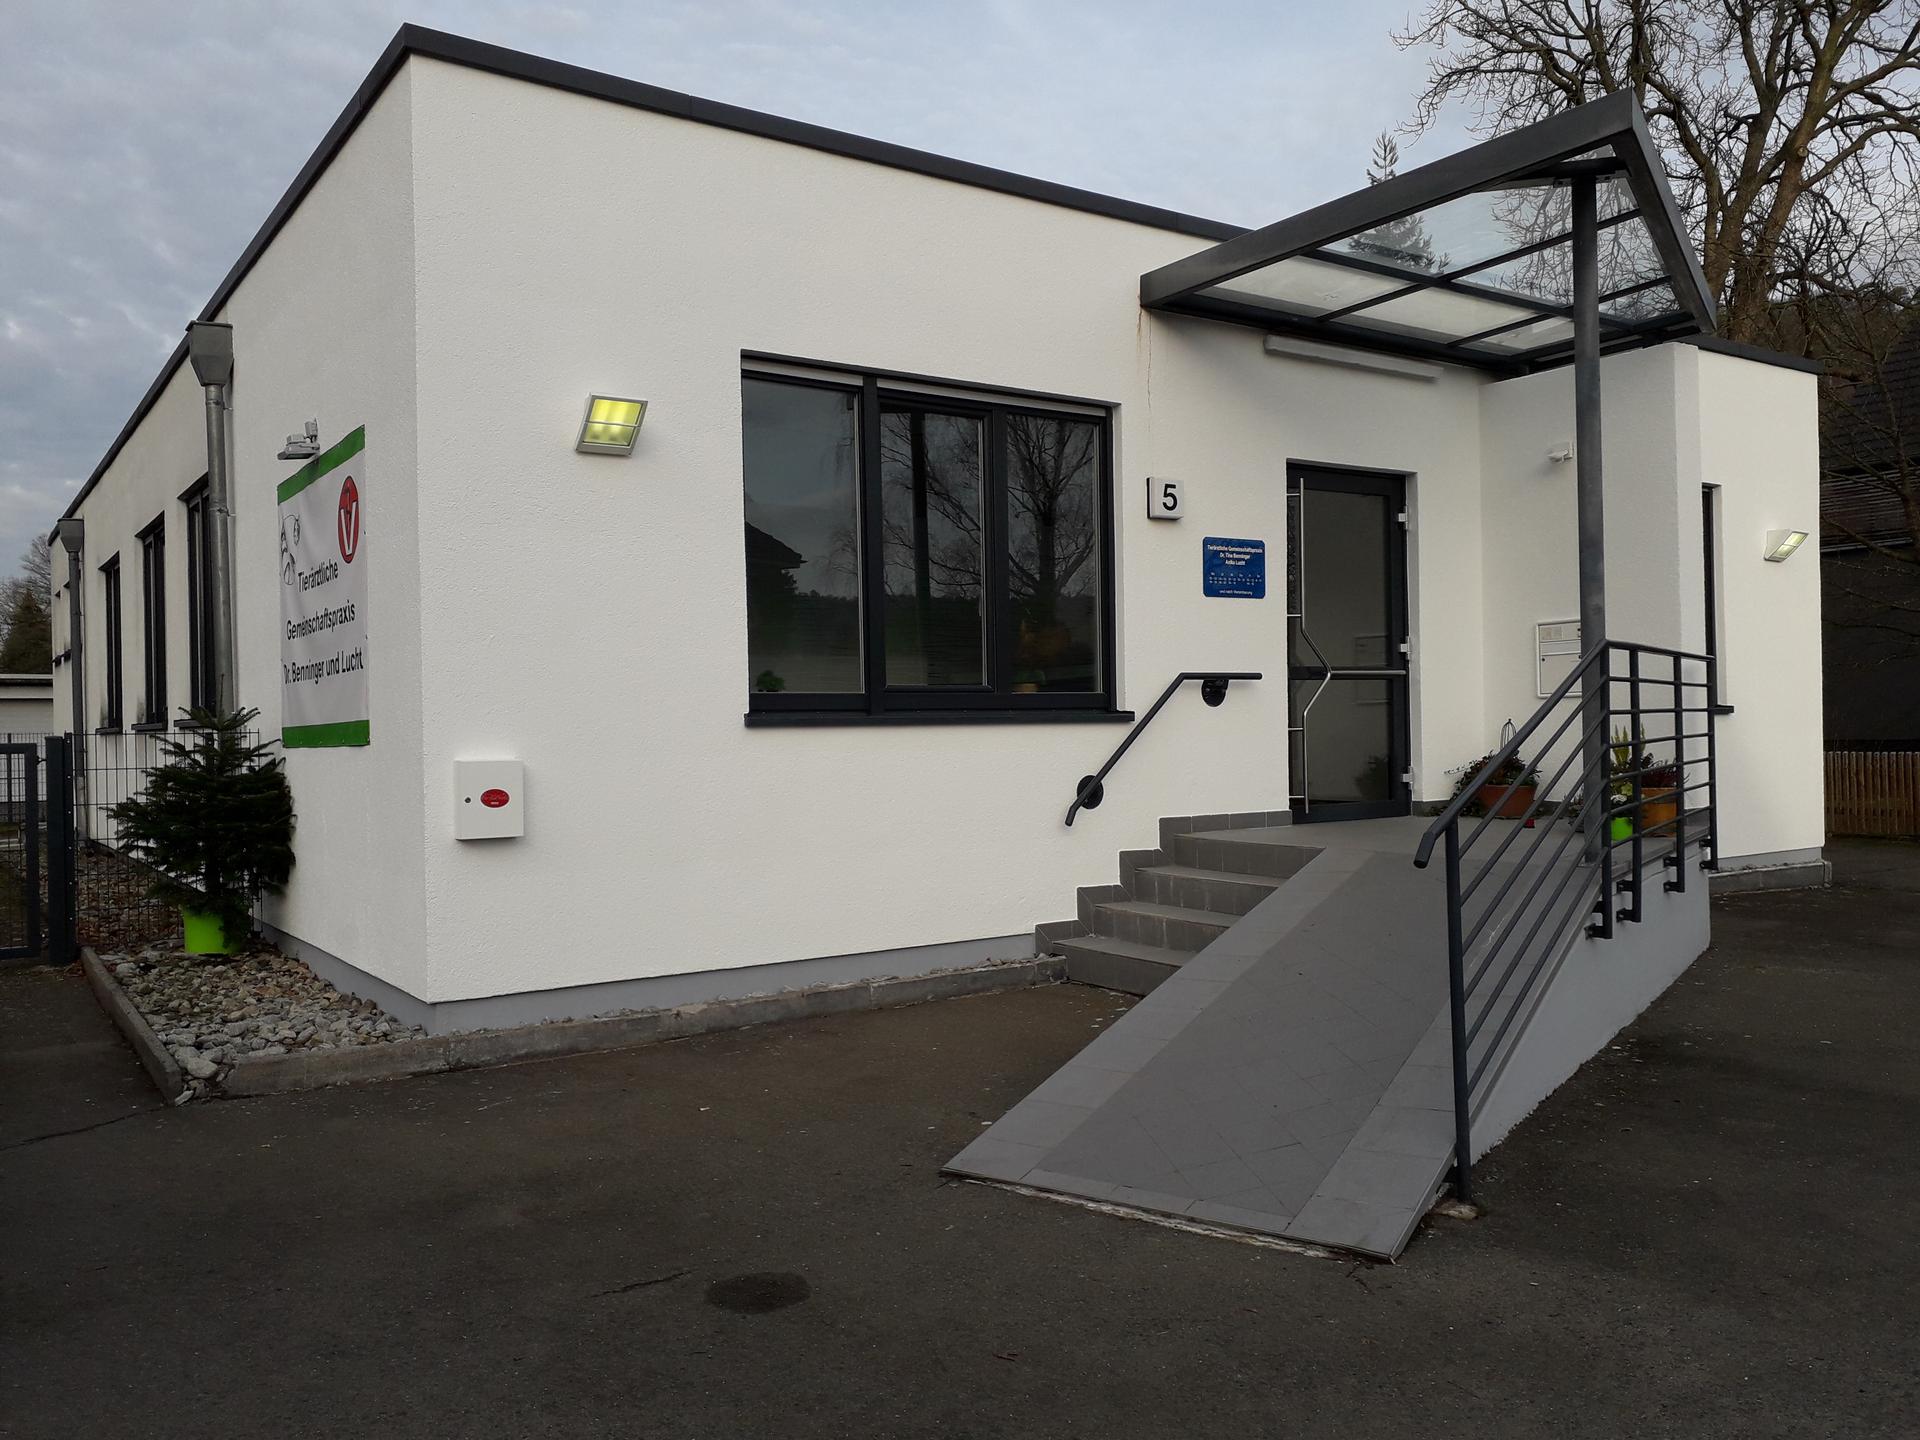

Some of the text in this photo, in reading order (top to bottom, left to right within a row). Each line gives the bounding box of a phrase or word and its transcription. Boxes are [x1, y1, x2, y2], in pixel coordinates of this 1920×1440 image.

[1162, 483, 1178, 511] 5
[340, 500, 358, 556] V
[298, 559, 339, 592] Tierärztliche
[286, 599, 356, 640] Gemeinschaftspraxis
[283, 646, 364, 685] Dr. Benninger und Lucht
